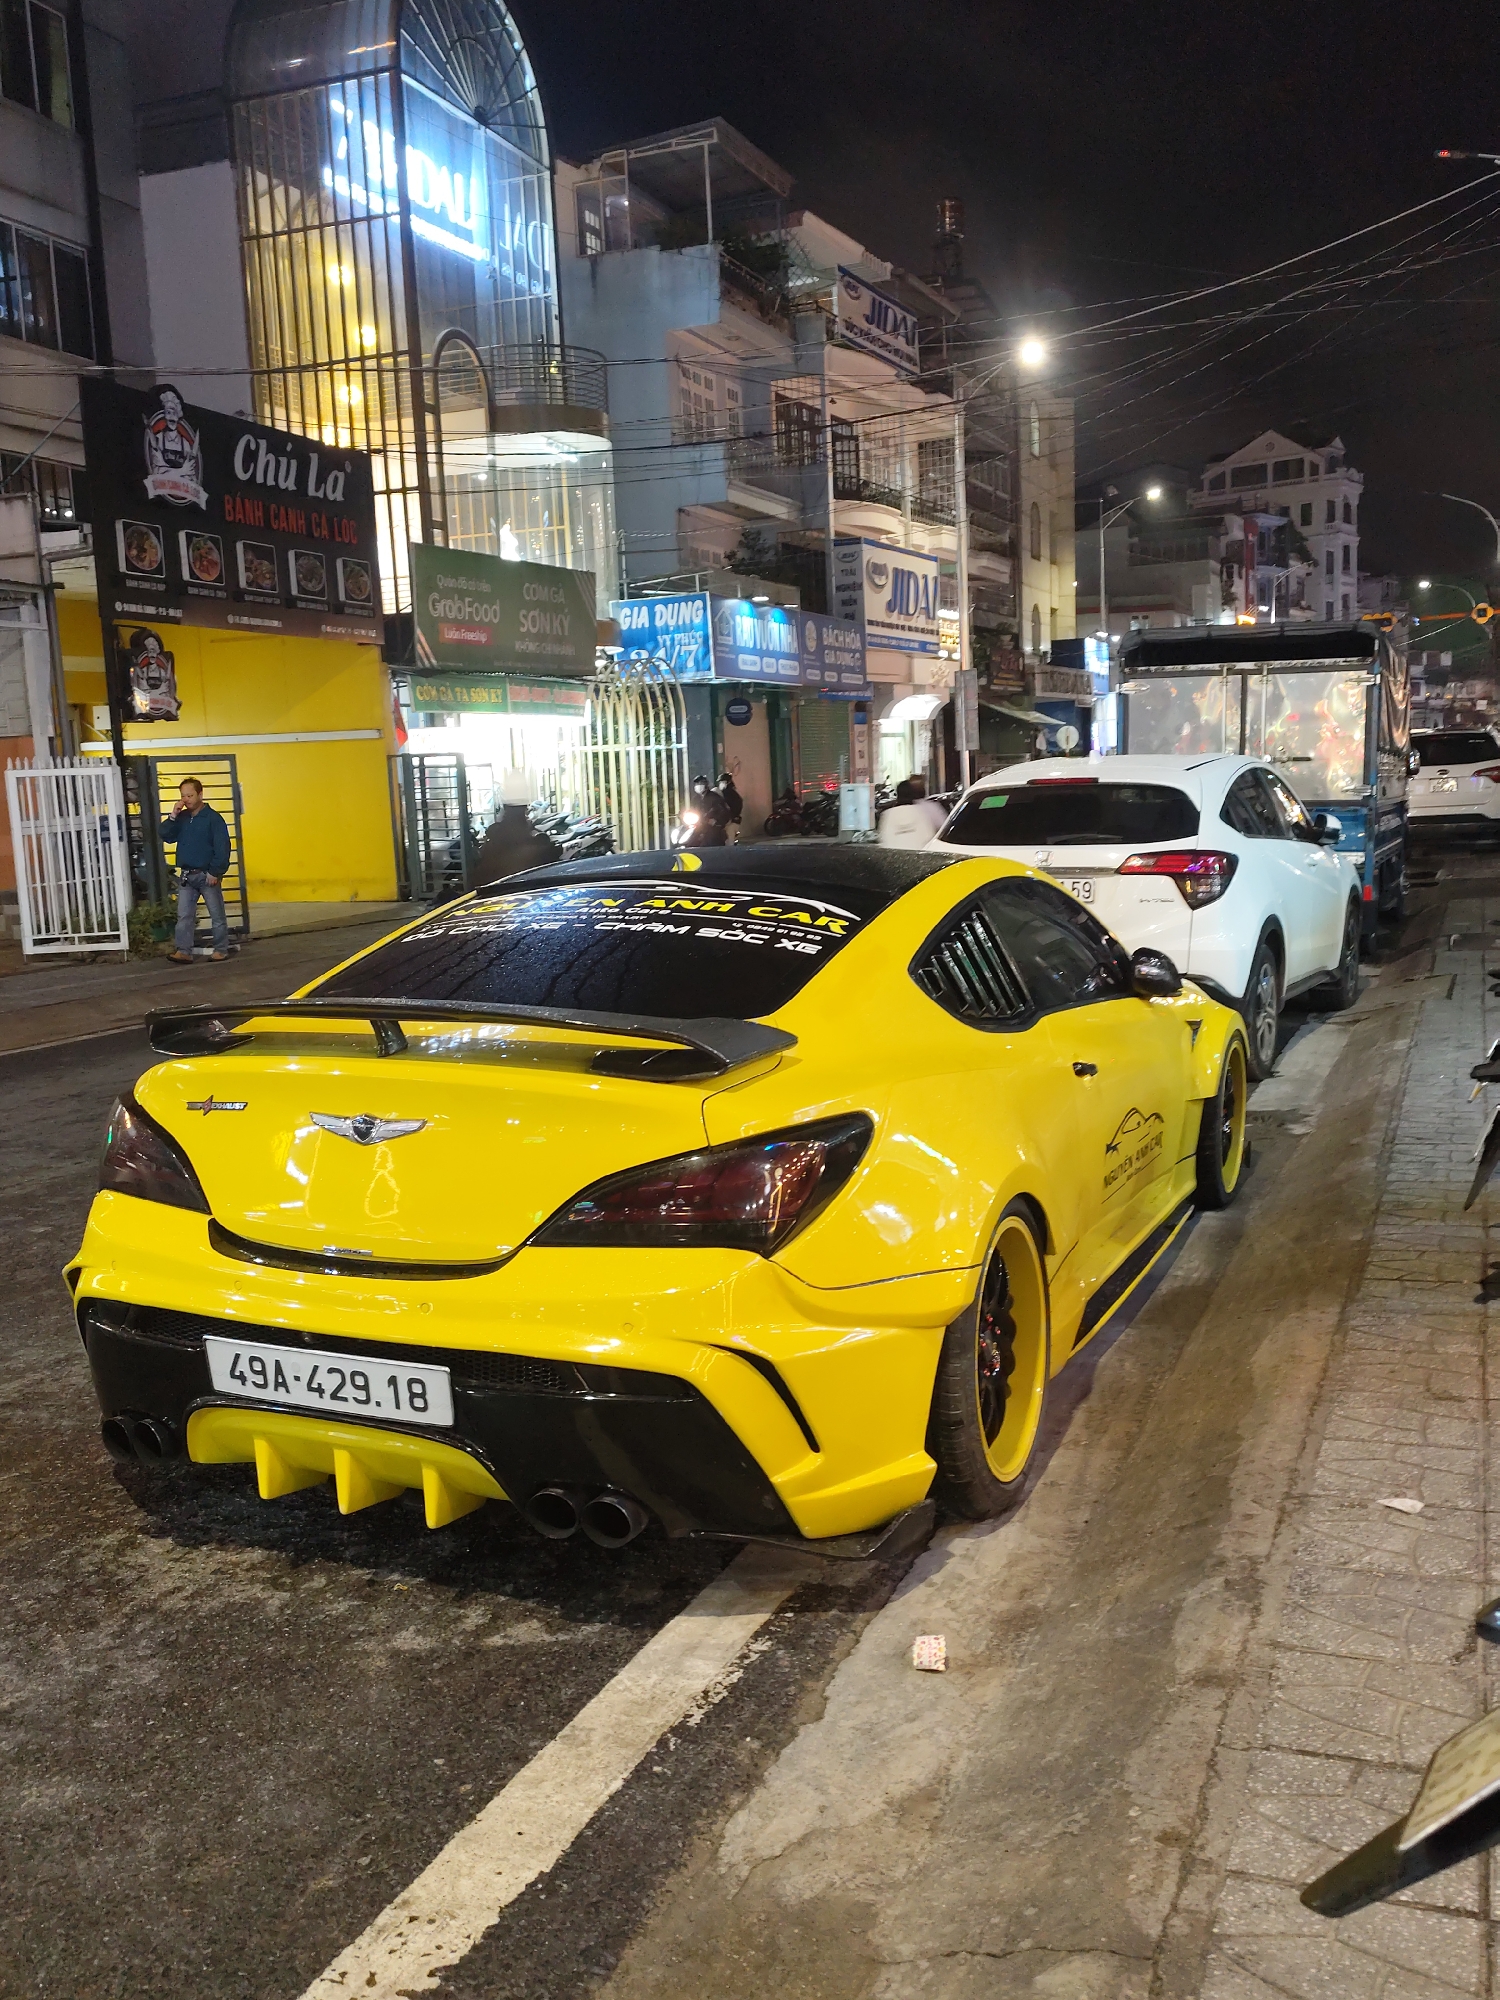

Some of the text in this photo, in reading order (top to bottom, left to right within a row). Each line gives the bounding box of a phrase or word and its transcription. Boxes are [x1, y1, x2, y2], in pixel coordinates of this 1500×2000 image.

[234, 434, 298, 491] Chú
[224, 492, 265, 527] BÁNH
[270, 503, 307, 534] CANH
[428, 592, 500, 623] GrabFood
[620, 600, 703, 630] GIA DỤNG
[625, 907, 672, 915] Care
[634, 899, 737, 912] ANH
[748, 906, 849, 935] CAR
[520, 921, 567, 930] XE
[594, 921, 692, 935] CHĂM
[694, 927, 770, 945] SÓC
[774, 938, 823, 955] XE
[211, 1102, 247, 1110] EXHAUST
[229, 1352, 429, 1413] 49A-429.18
